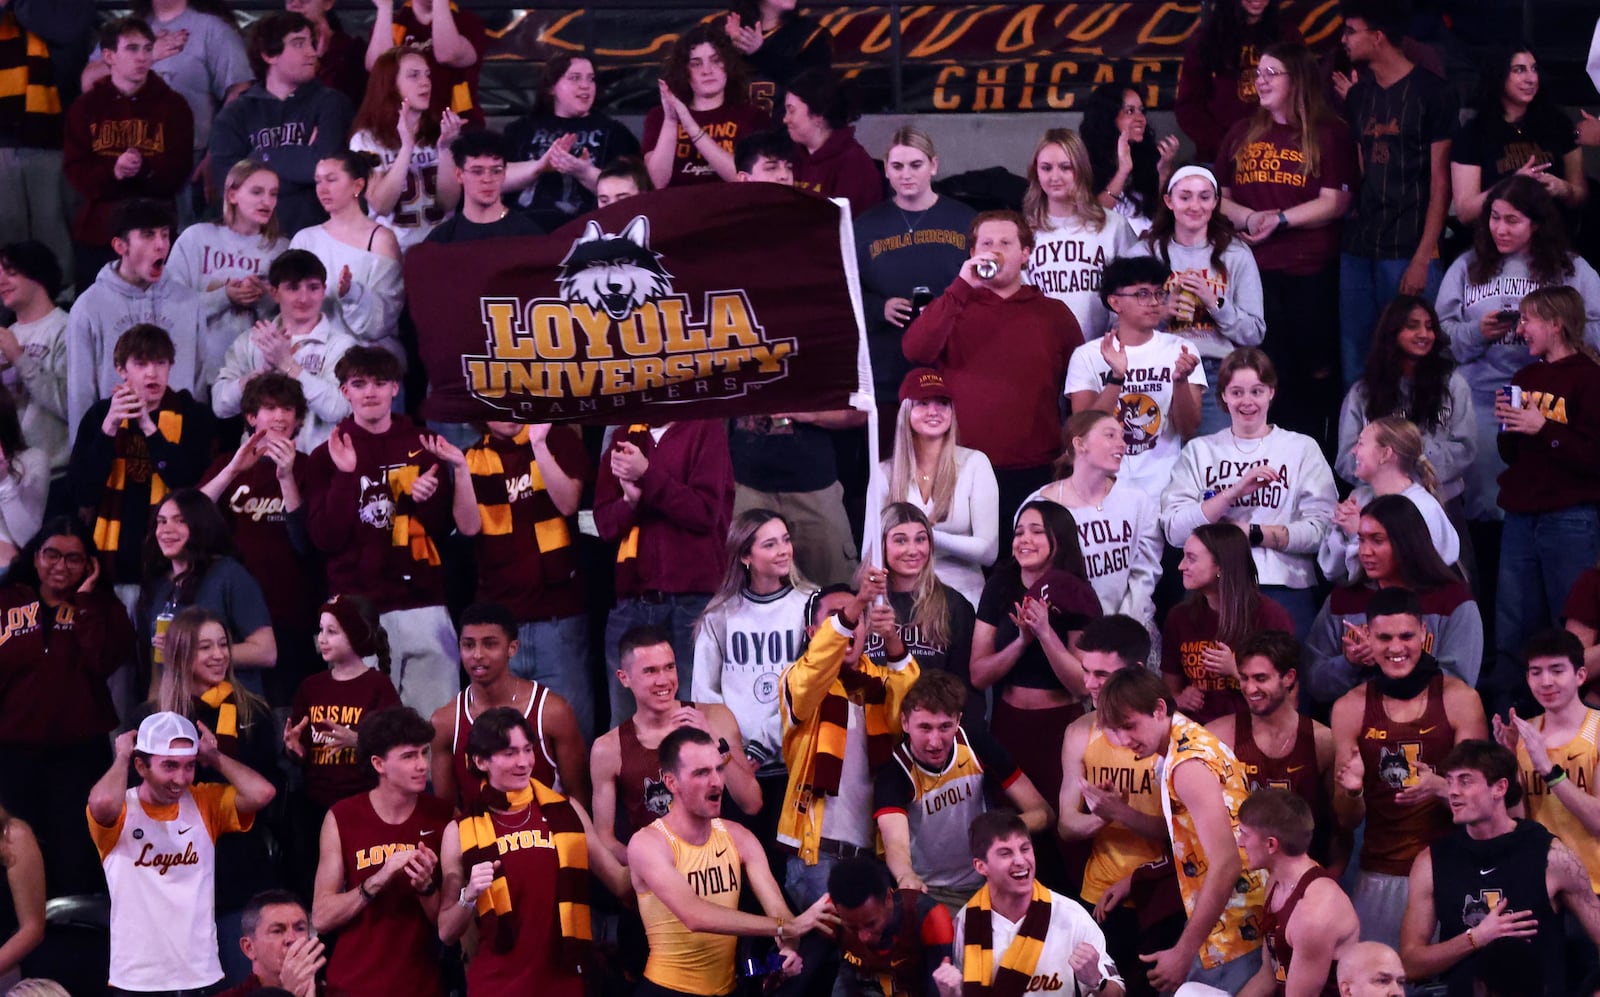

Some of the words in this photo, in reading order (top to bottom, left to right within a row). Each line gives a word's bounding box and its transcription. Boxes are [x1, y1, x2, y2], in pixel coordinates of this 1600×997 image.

[933, 59, 1184, 110] CHICAG
[1260, 160, 1280, 171] GO
[1263, 148, 1308, 163] BLESS
[1235, 171, 1307, 187] RAMBLERS!
[869, 232, 911, 260] LOYOLA
[914, 228, 966, 249] CHICAGO
[1464, 278, 1501, 307] LOYOLA
[486, 293, 760, 361] LOYOLA
[466, 341, 792, 398] UNIVERSITY
[1099, 367, 1171, 387] LYOLA
[1121, 383, 1162, 393] MBLERS
[1205, 459, 1289, 490] LOYA
[229, 484, 285, 522] Loyo
[1077, 519, 1132, 548] YOLA
[1083, 545, 1130, 578] ICAGO
[725, 629, 796, 665] LOYOL
[327, 705, 339, 724] IS
[341, 705, 363, 725] MY
[925, 782, 972, 815] LOYOLA
[134, 841, 199, 876] Loyola
[687, 862, 738, 897] OYOLA
